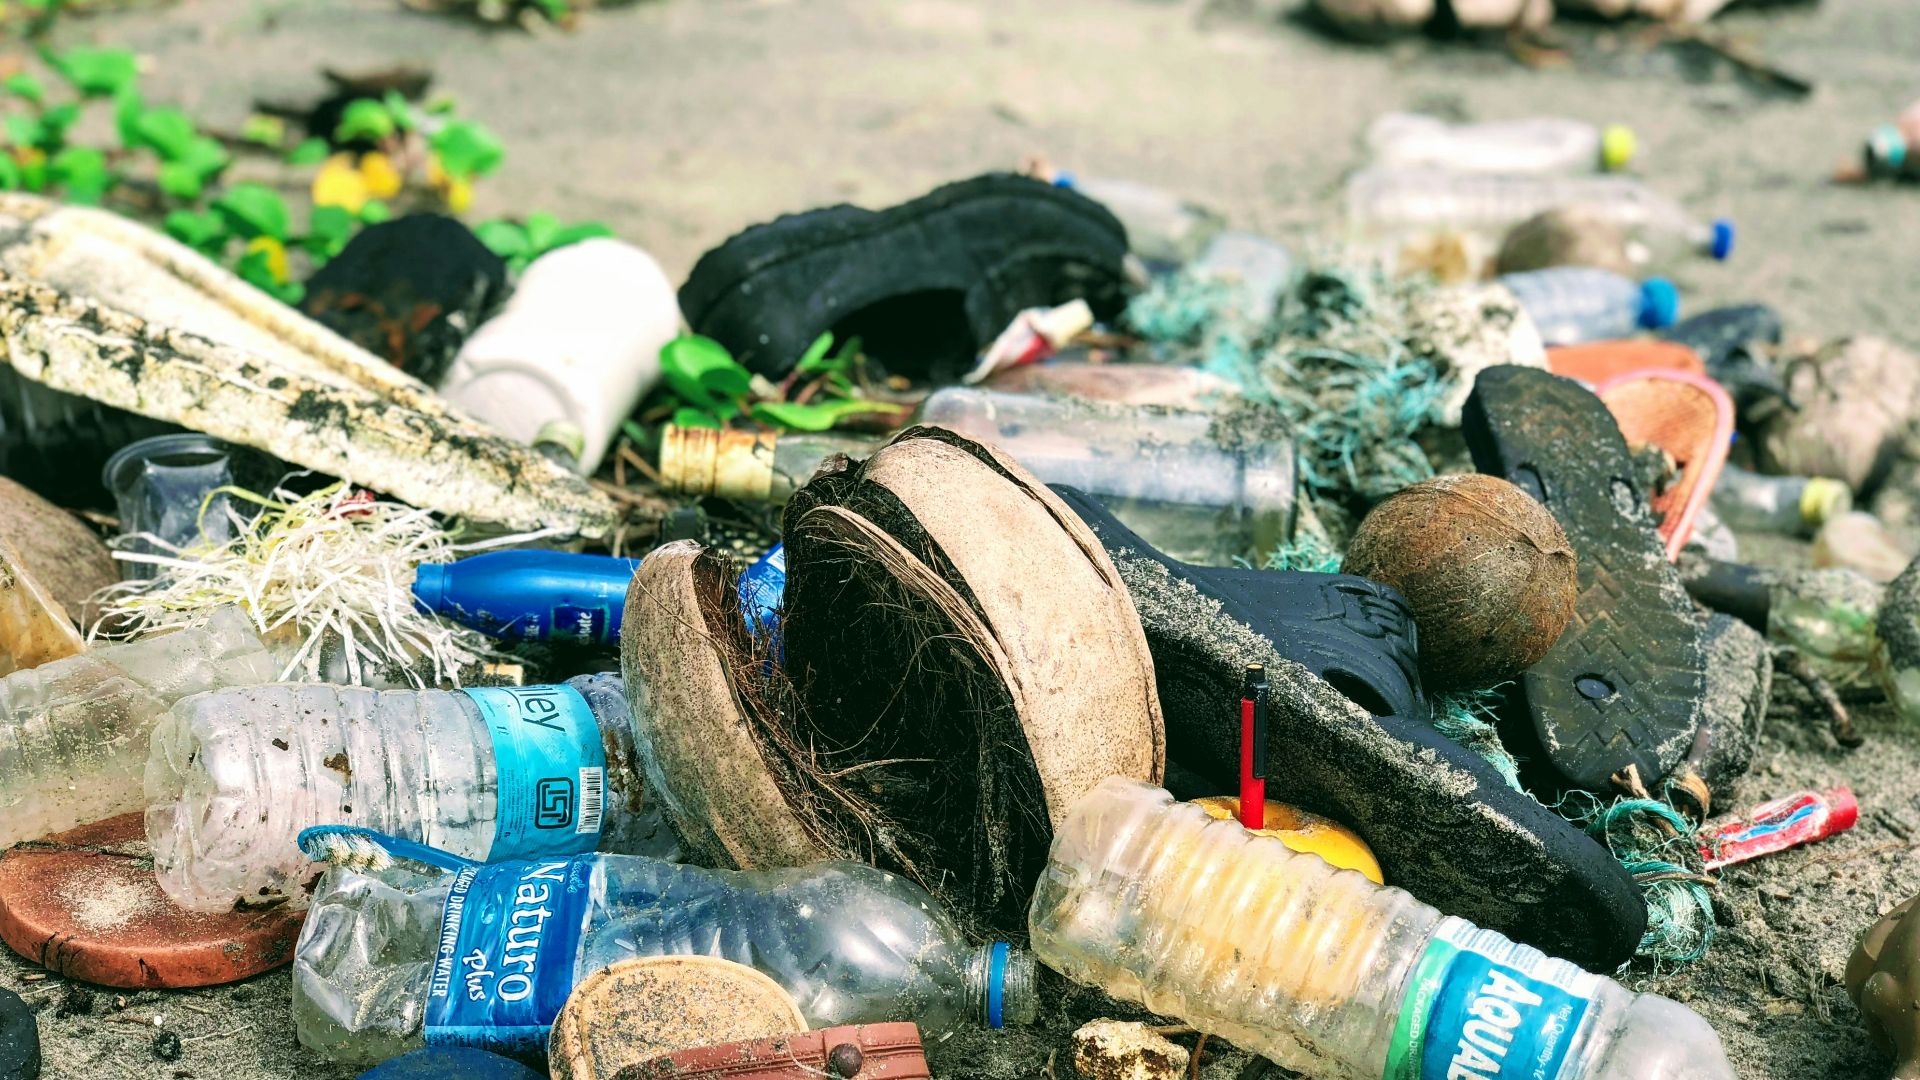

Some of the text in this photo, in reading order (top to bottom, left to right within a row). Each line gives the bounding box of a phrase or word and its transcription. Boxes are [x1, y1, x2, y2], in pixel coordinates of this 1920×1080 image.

[513, 686, 566, 732] lley
[431, 866, 479, 997] CKAGED DRINKING WATER
[497, 861, 569, 1002] Naturo
[1409, 977, 1431, 1039] PACKAGED
[1557, 1003, 1574, 1022] Net
